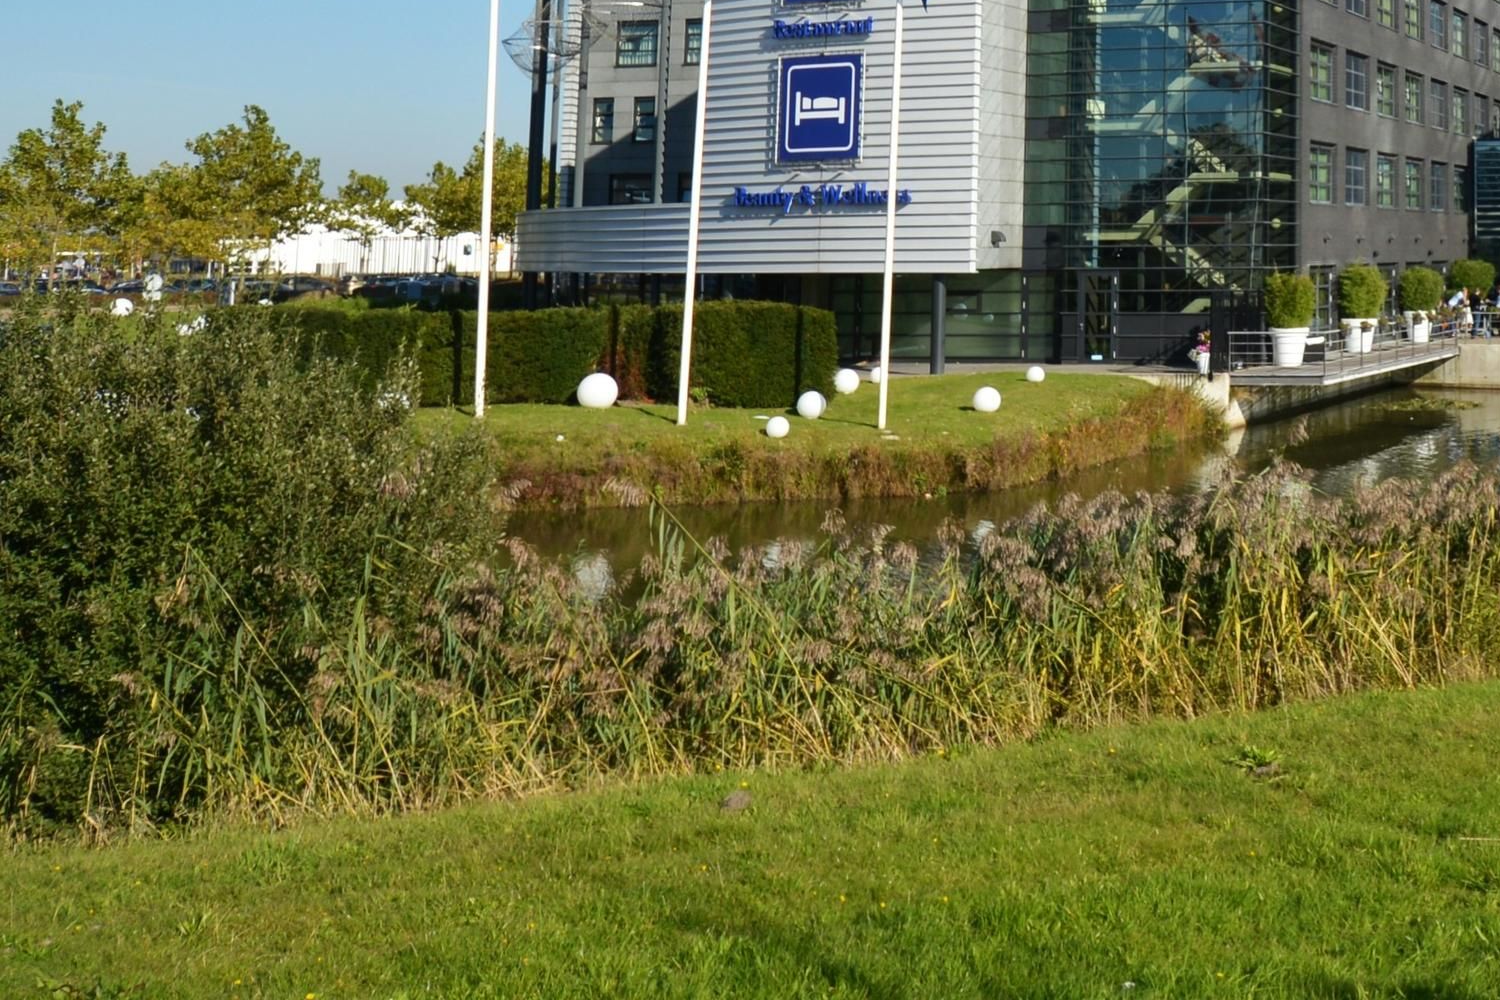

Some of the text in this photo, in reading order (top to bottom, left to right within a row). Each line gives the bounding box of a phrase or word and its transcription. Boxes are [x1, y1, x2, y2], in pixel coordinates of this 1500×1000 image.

[773, 16, 873, 39] Restaurant
[734, 182, 913, 213] Beauty & Wellnes
